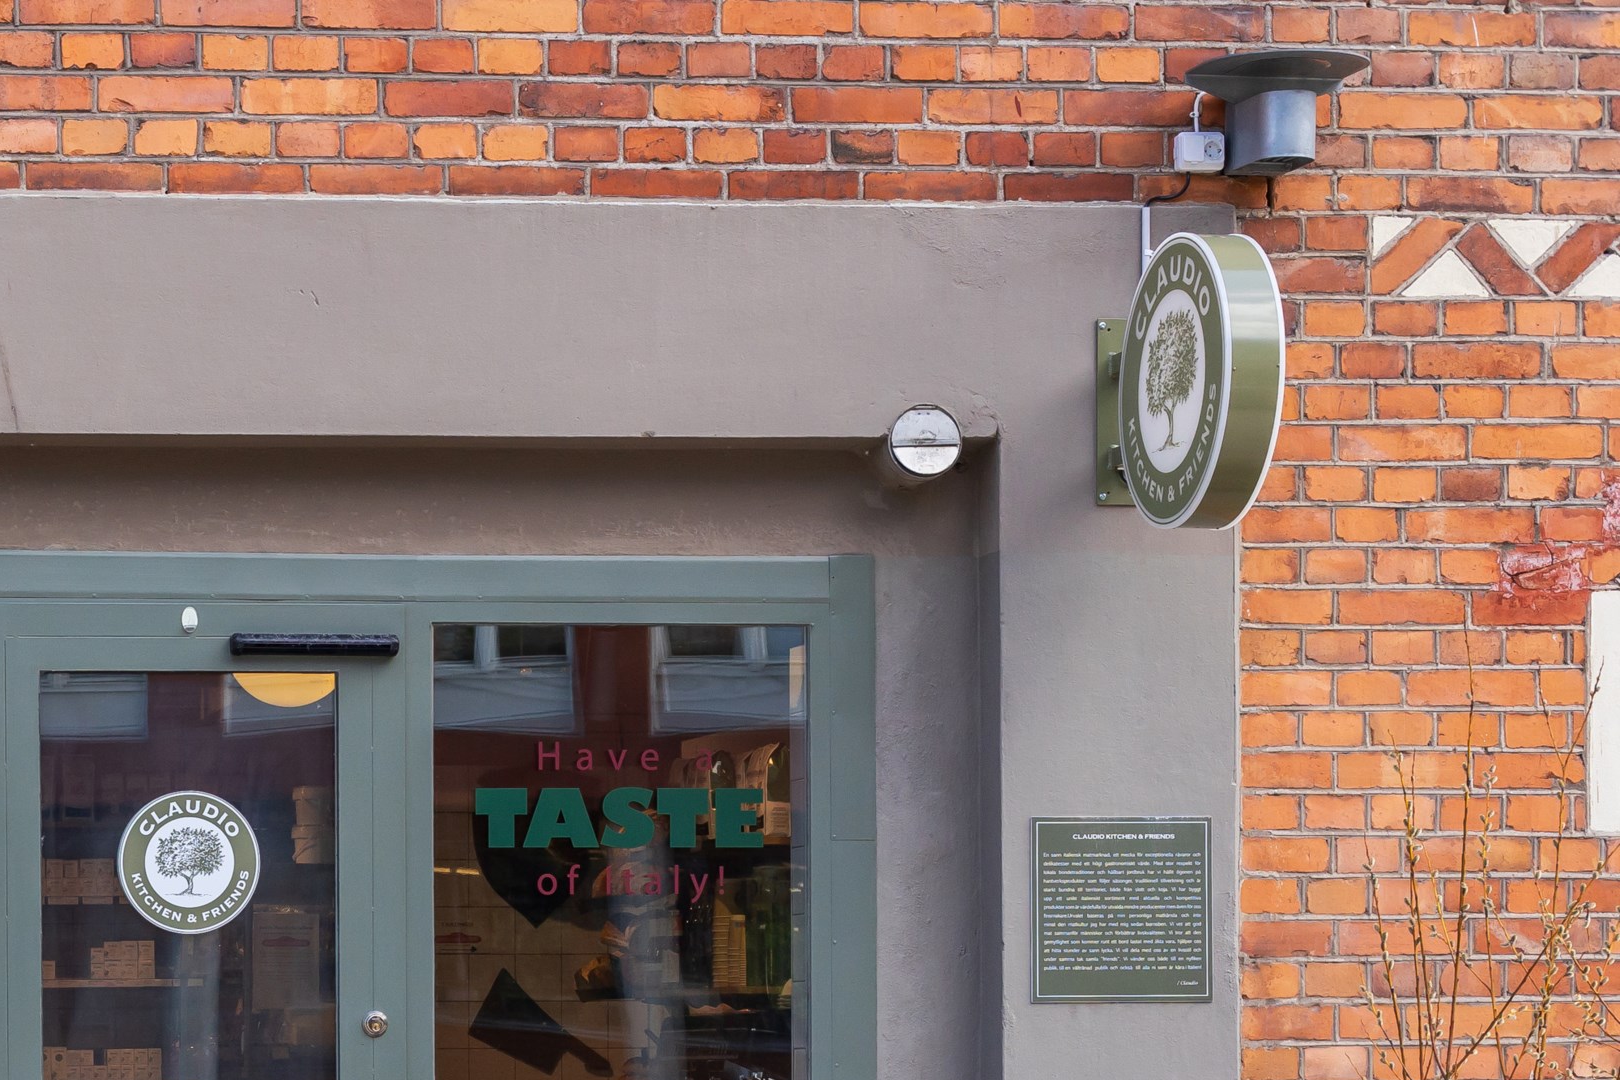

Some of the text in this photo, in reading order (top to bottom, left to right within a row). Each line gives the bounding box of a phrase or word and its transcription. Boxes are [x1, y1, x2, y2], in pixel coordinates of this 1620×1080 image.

[1135, 254, 1210, 340] CLAUDIO
[1128, 382, 1217, 503] KITCHEN & FRIENDS
[537, 741, 714, 771] Have a
[139, 799, 240, 838] CLAUDIO
[475, 787, 764, 848] TASTE
[130, 870, 249, 923] KITCHEN & FRIENDS
[536, 864, 726, 902] of Italy!
